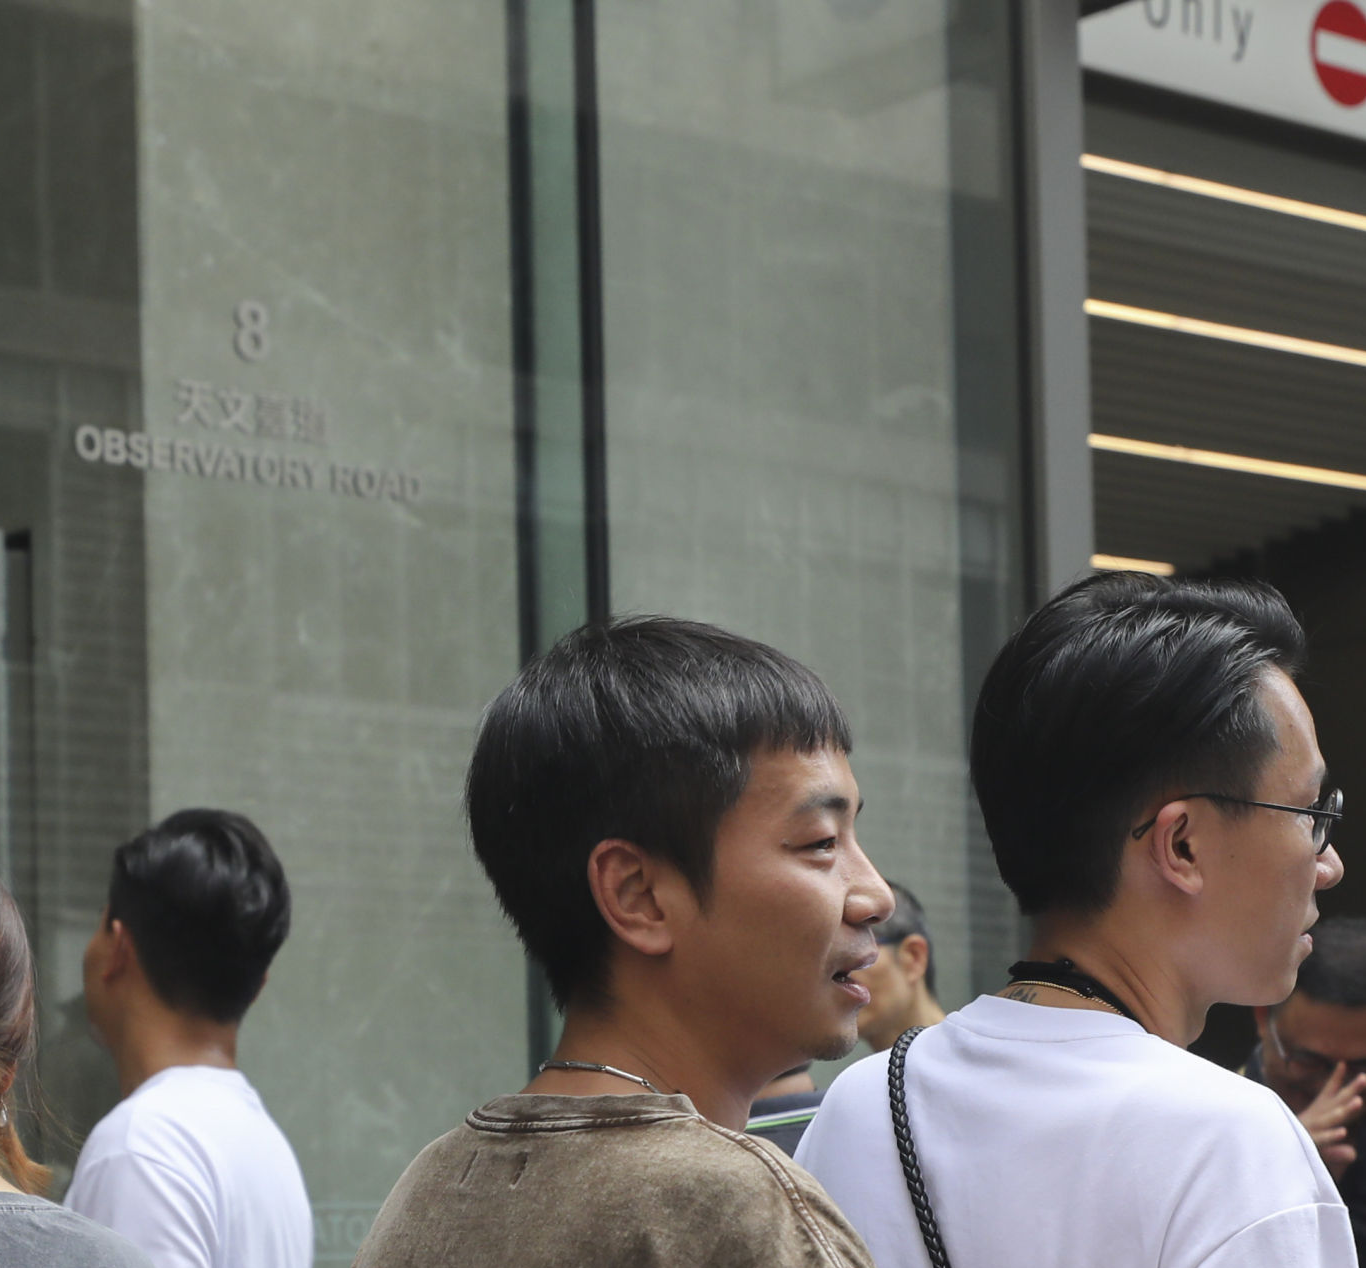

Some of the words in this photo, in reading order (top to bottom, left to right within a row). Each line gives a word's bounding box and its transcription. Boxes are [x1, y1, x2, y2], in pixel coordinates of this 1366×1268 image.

[234, 300, 270, 362] 8
[75, 424, 319, 490] OBSERVATORY
[329, 462, 424, 503] ROAD
